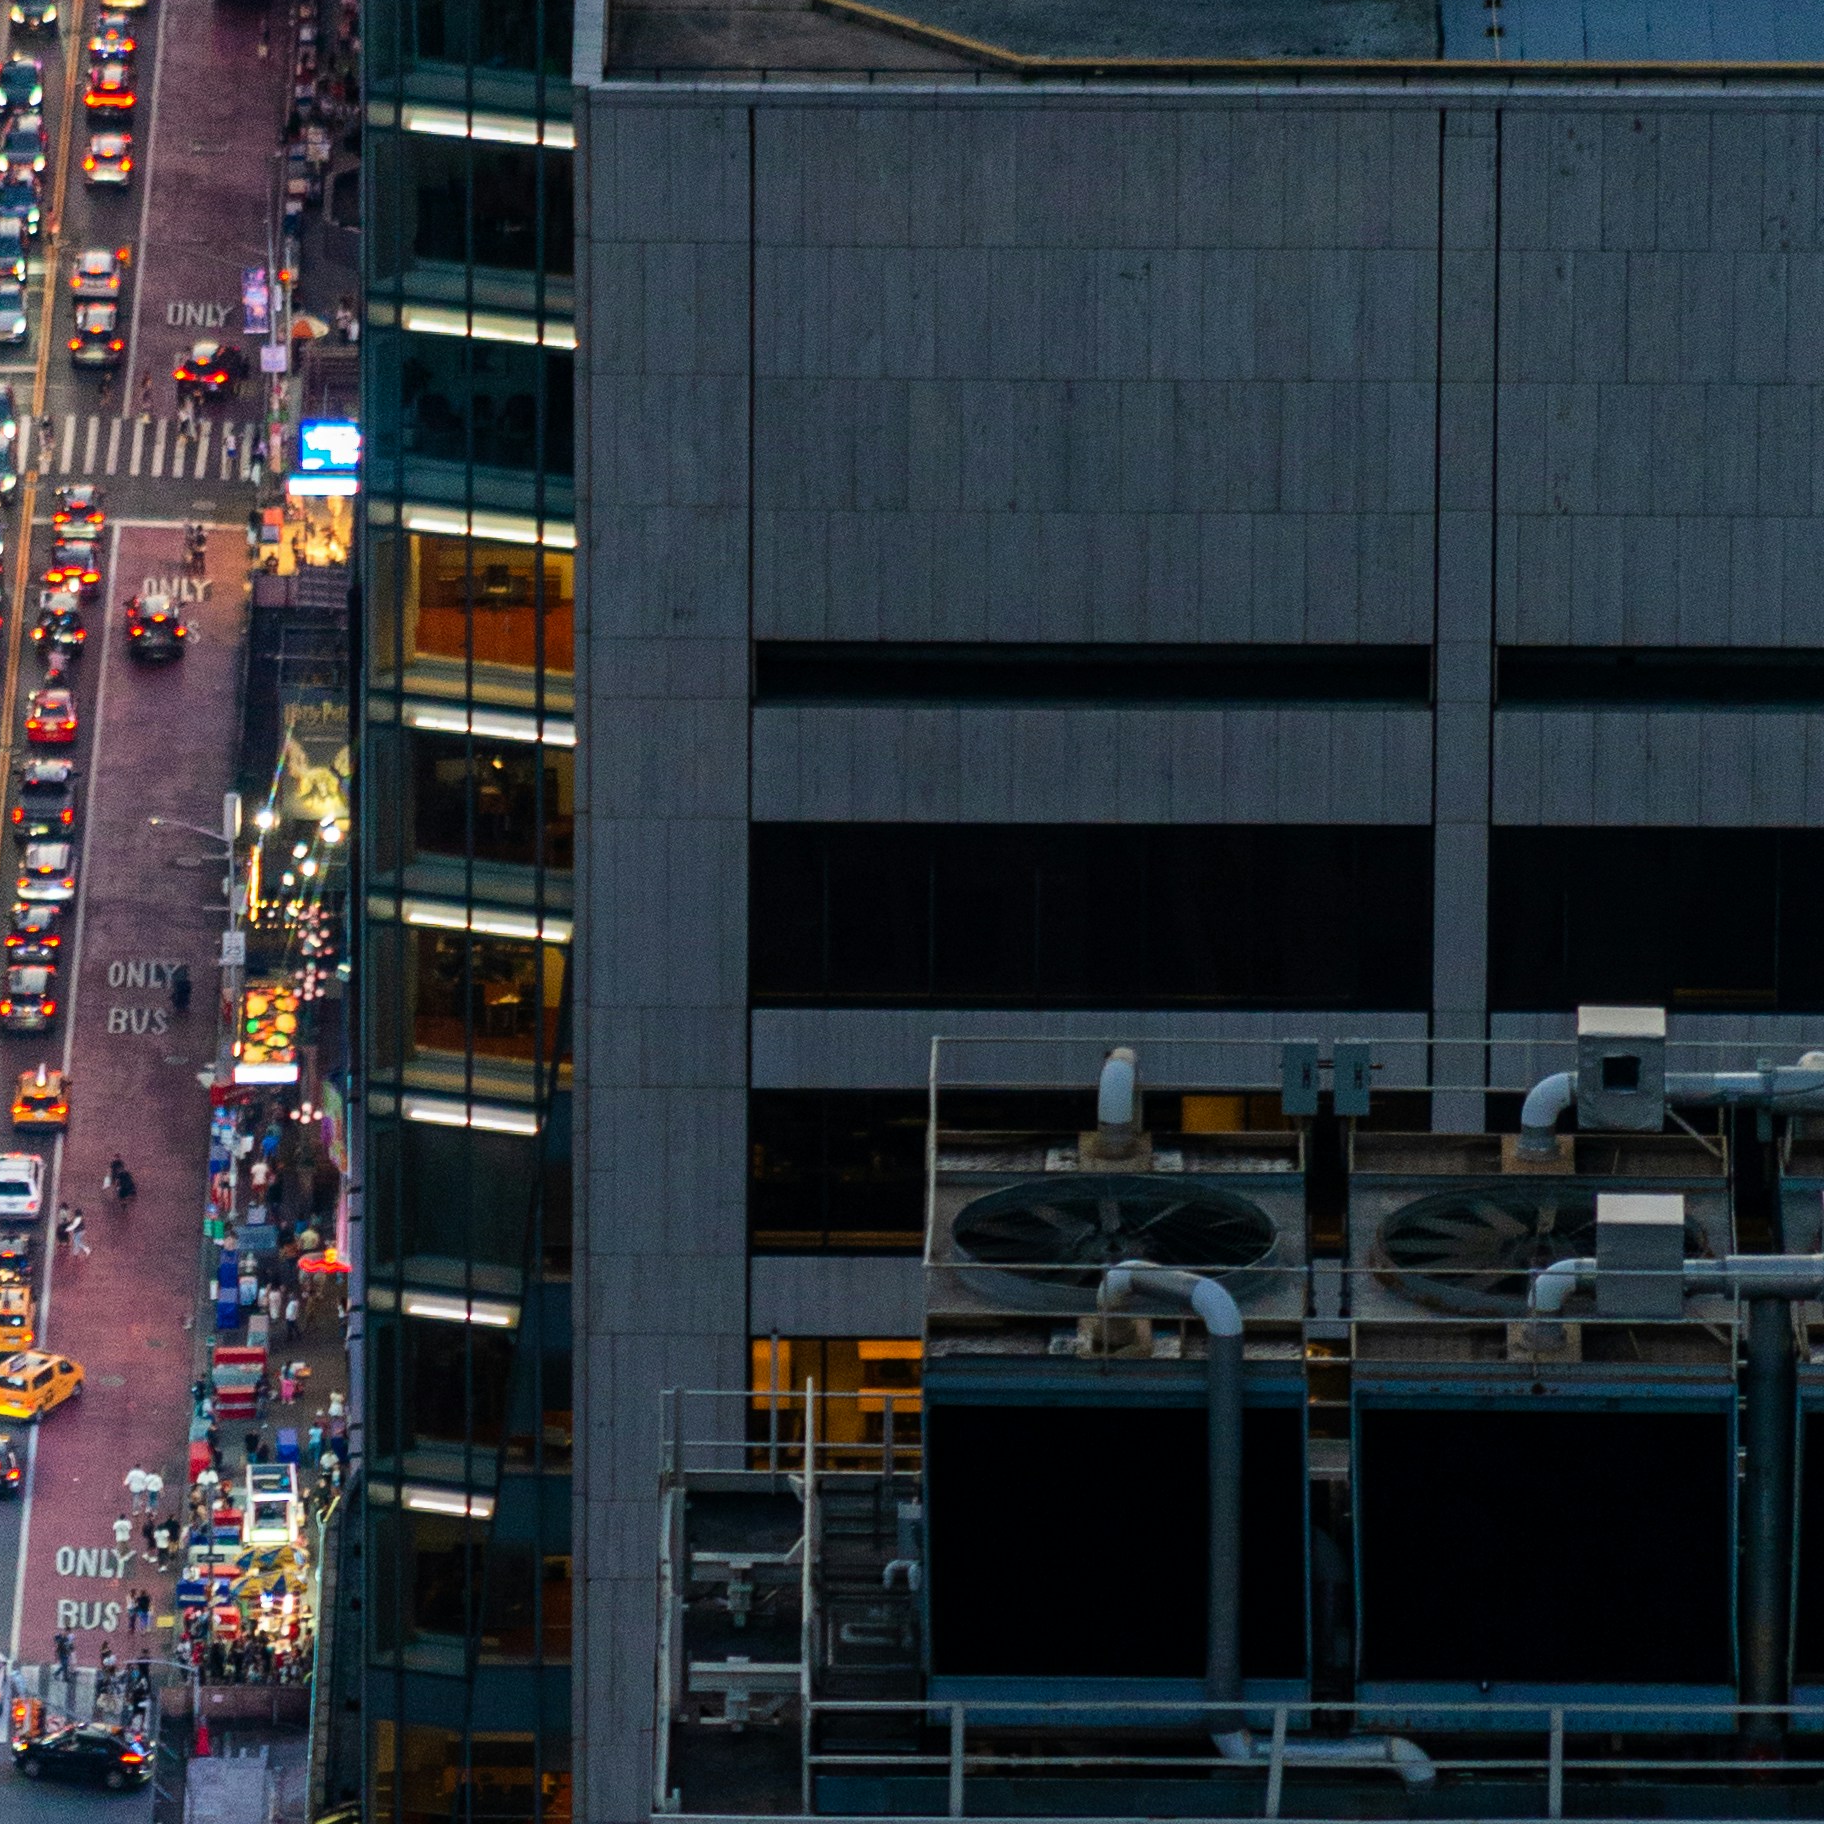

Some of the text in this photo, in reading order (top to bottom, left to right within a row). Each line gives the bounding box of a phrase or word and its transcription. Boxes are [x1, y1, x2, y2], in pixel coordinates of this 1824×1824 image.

[166, 302, 234, 328] ONLY
[142, 576, 213, 603] ONLY
[107, 960, 182, 989] ONLY
[107, 1007, 169, 1035] BUS
[55, 1545, 137, 1579] ONLY
[57, 1599, 121, 1633] BUS
